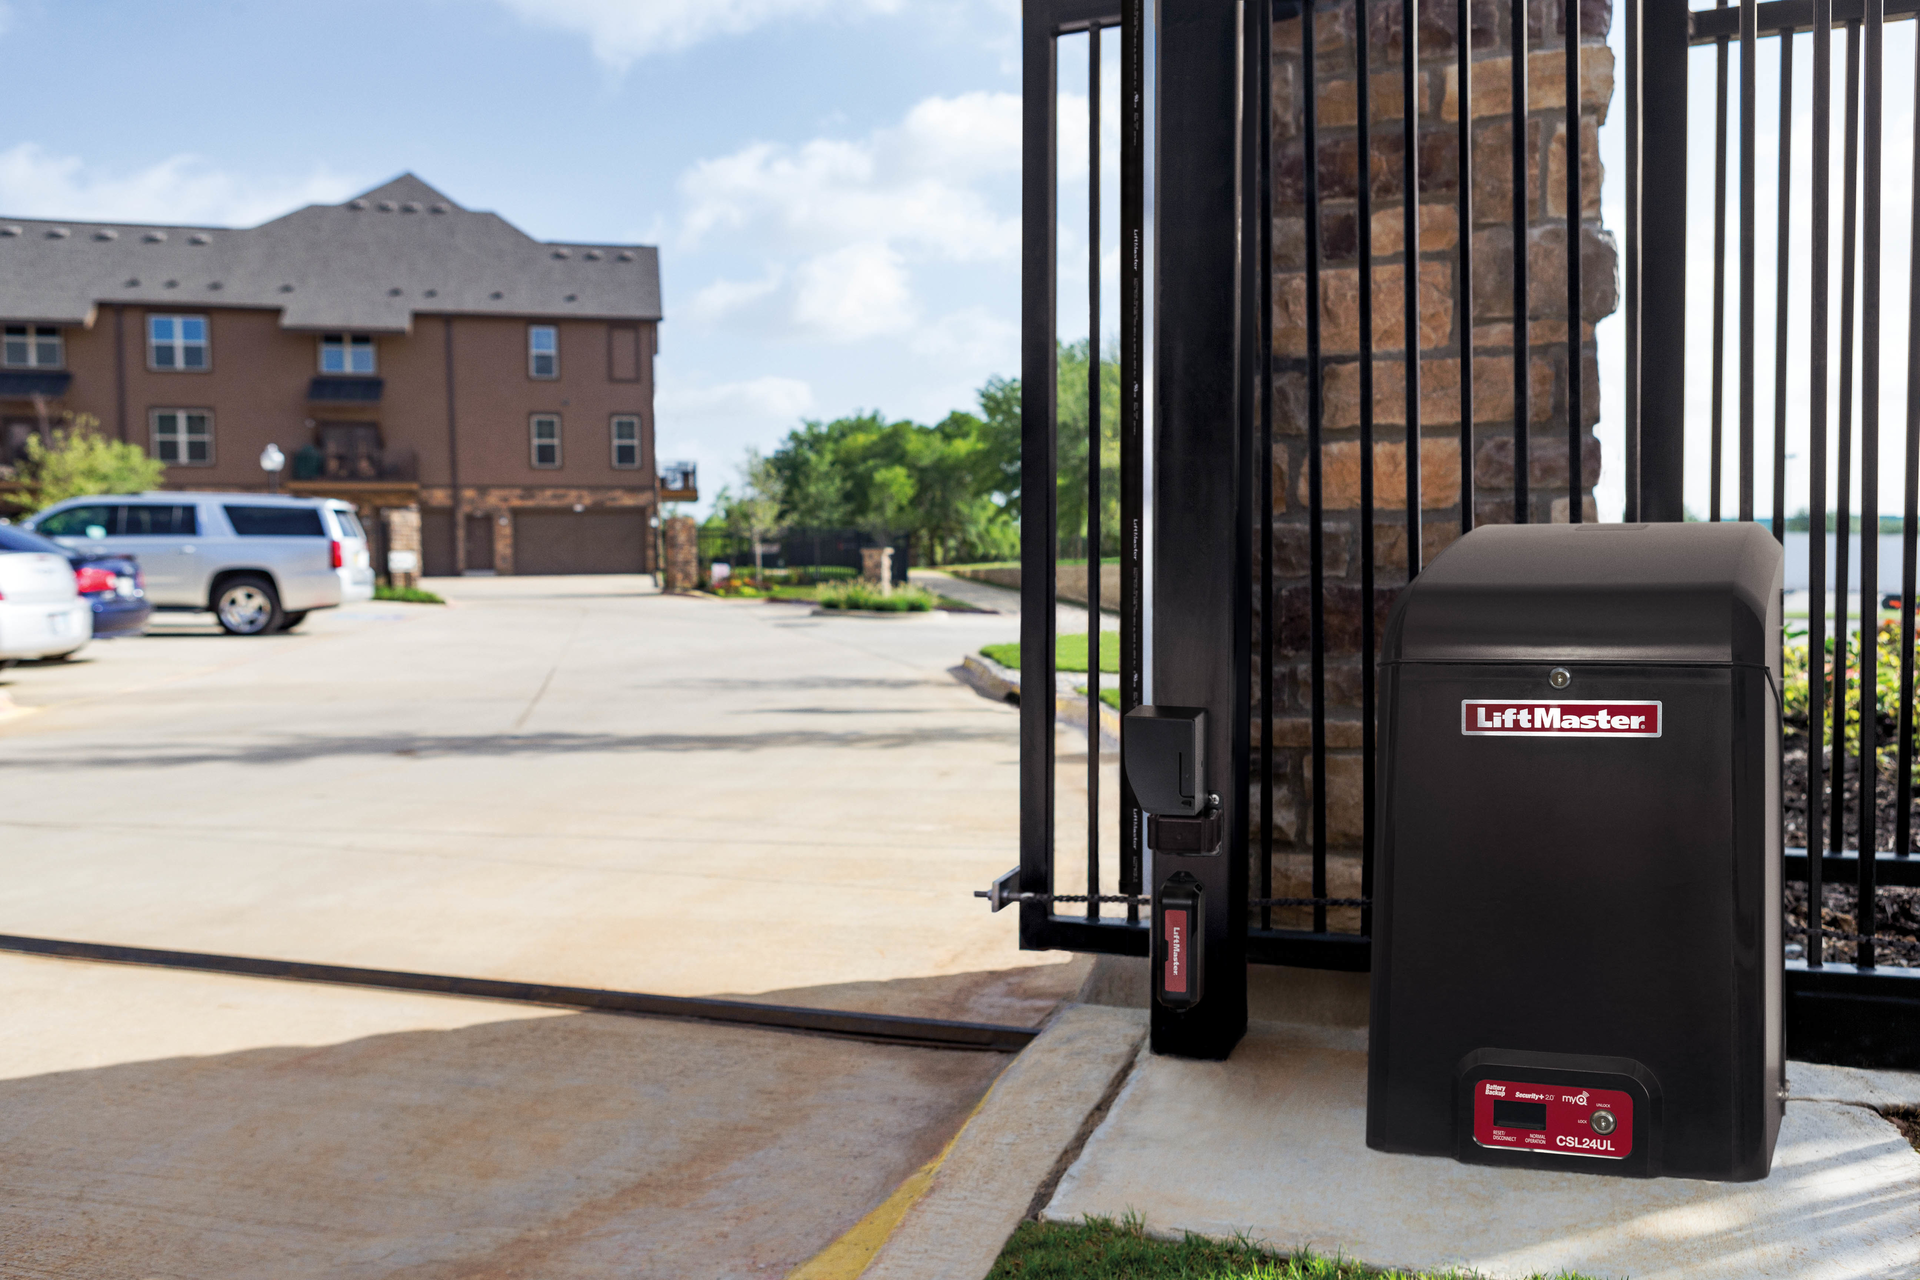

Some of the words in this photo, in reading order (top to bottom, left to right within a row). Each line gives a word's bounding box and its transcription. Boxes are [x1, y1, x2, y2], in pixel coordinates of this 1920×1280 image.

[1477, 707, 1645, 729] LiftMaster
[1485, 1084, 1506, 1092] Battery
[1485, 1089, 1505, 1097] Backup
[1515, 1091, 1544, 1100] Security+
[1562, 1093, 1588, 1106] myQ
[1556, 1136, 1615, 1151] CSL24UL
